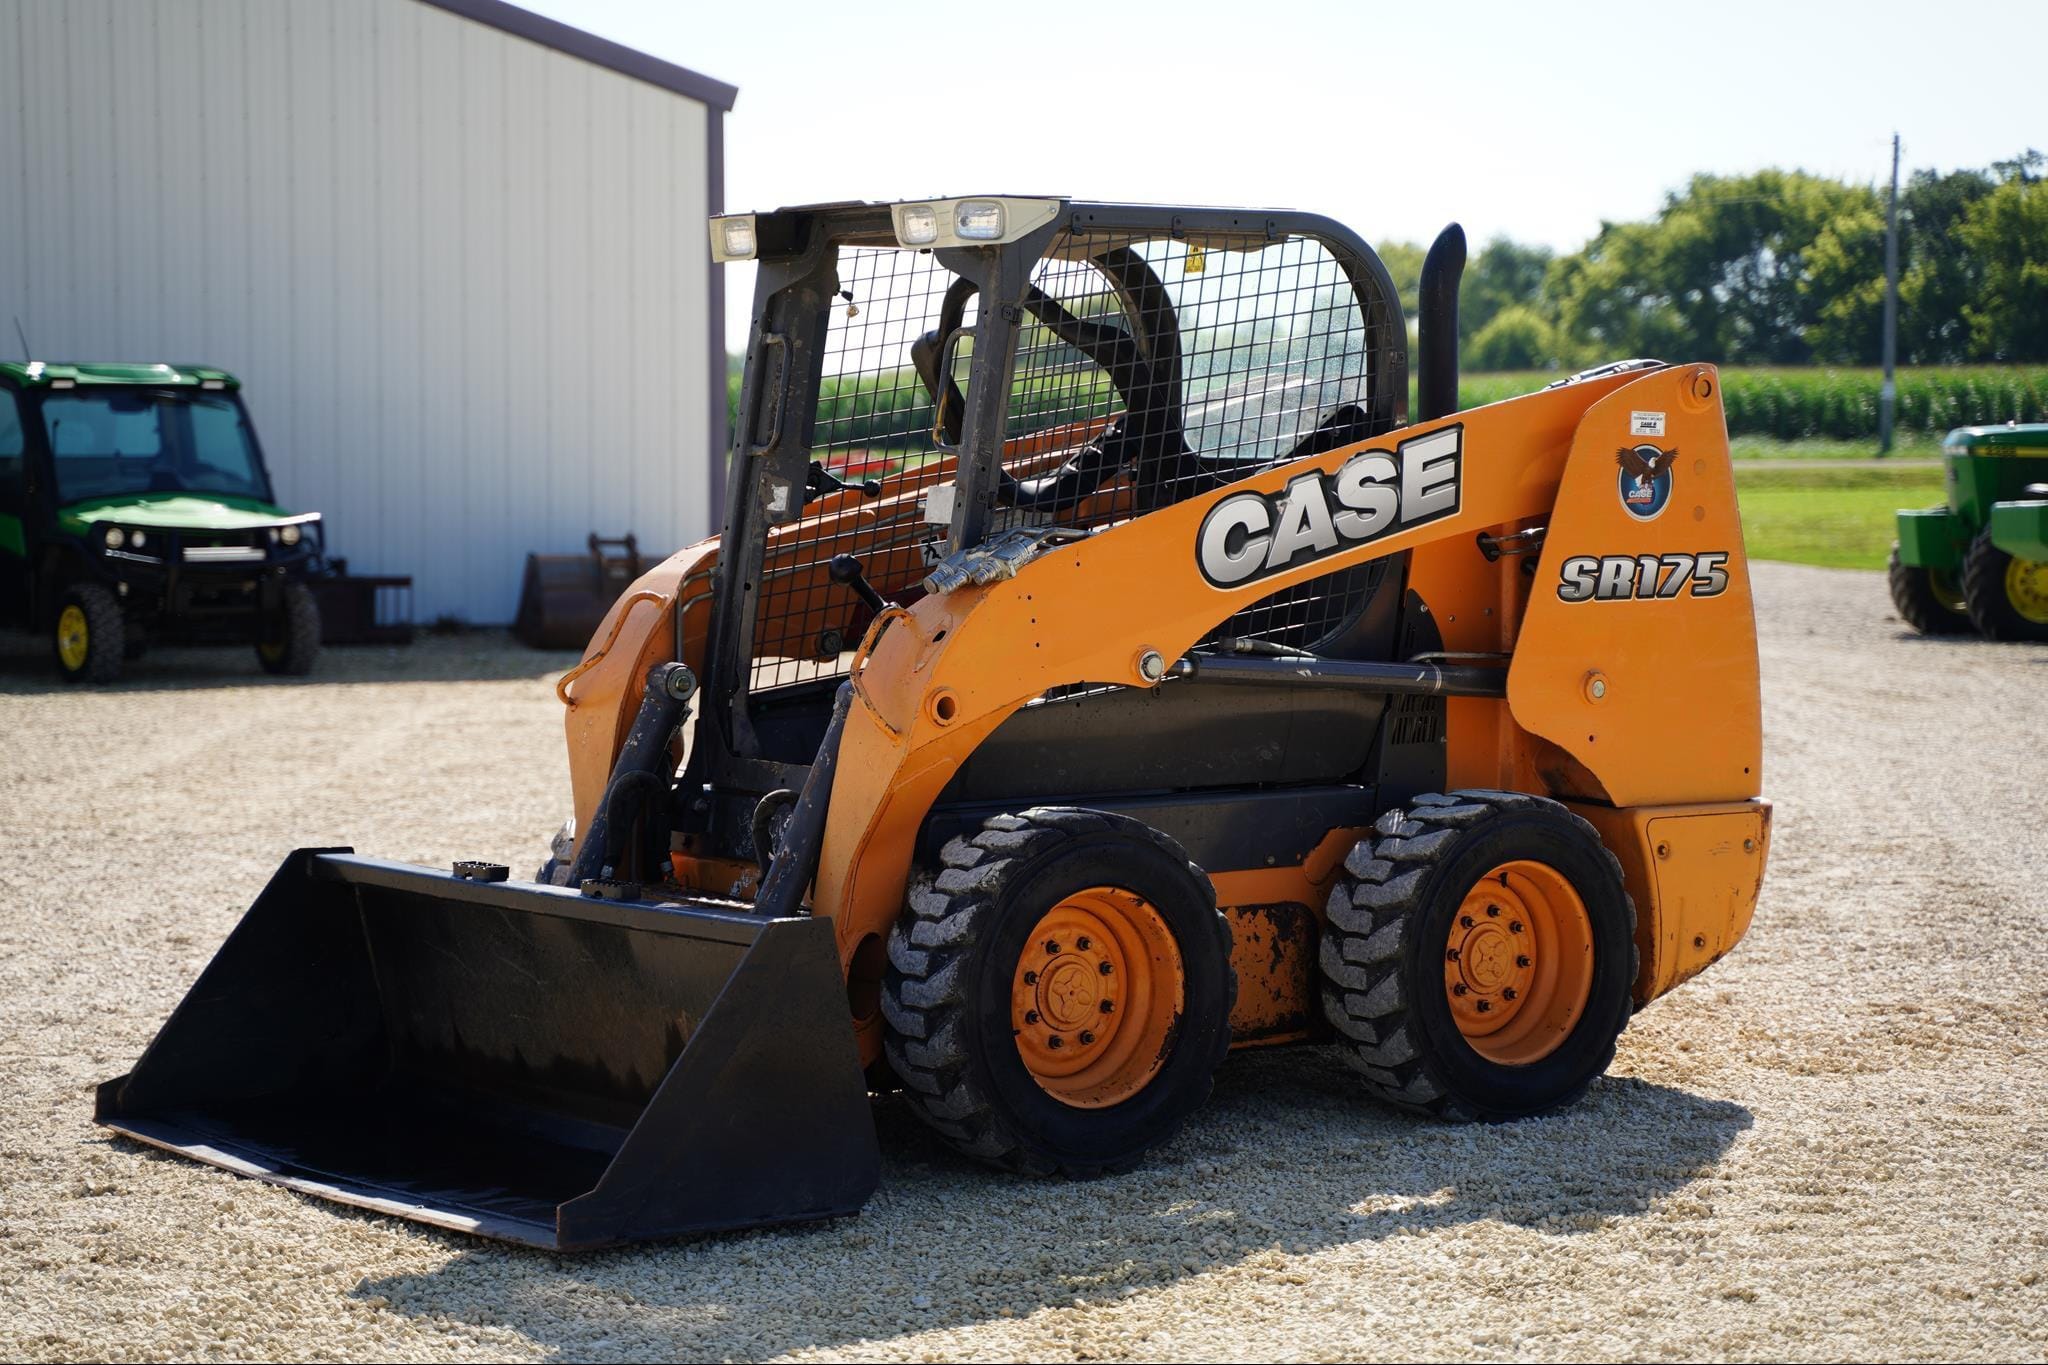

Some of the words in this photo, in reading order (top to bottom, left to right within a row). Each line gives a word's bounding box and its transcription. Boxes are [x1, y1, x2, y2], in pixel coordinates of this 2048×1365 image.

[1199, 427, 1461, 586] CASE
[1628, 489, 1653, 498] CASE
[1558, 553, 1729, 602] SR175
